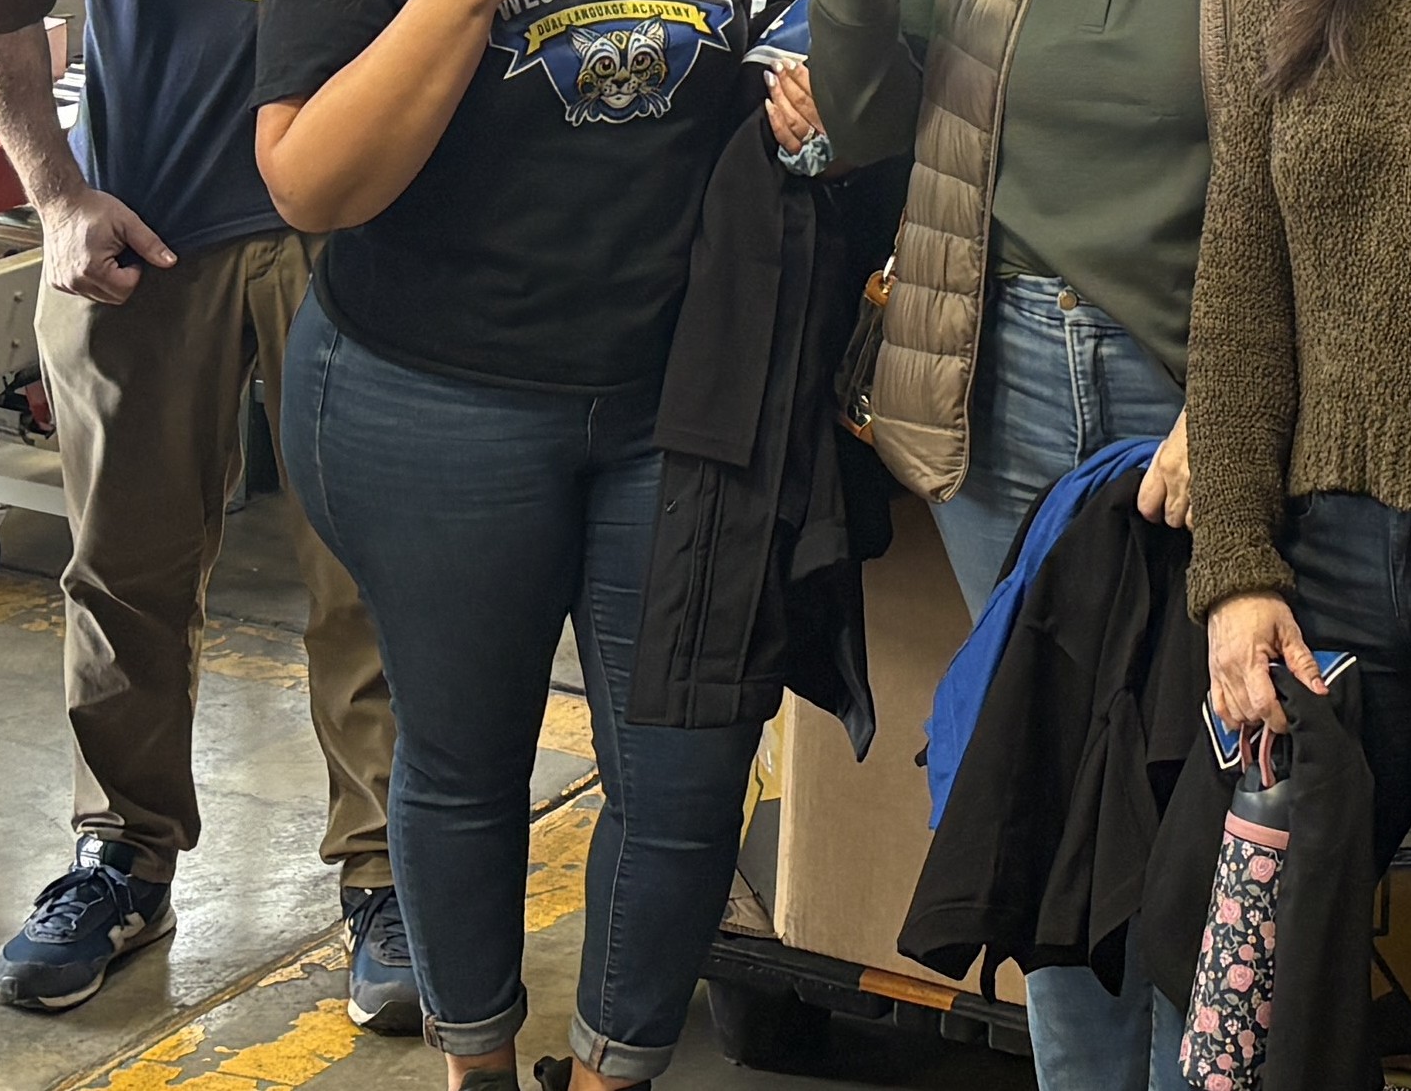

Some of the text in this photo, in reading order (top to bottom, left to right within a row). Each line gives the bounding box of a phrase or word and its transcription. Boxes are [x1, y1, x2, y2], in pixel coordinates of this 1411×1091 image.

[537, 2, 692, 36] DUAL LANGUAGE ACADEMY
